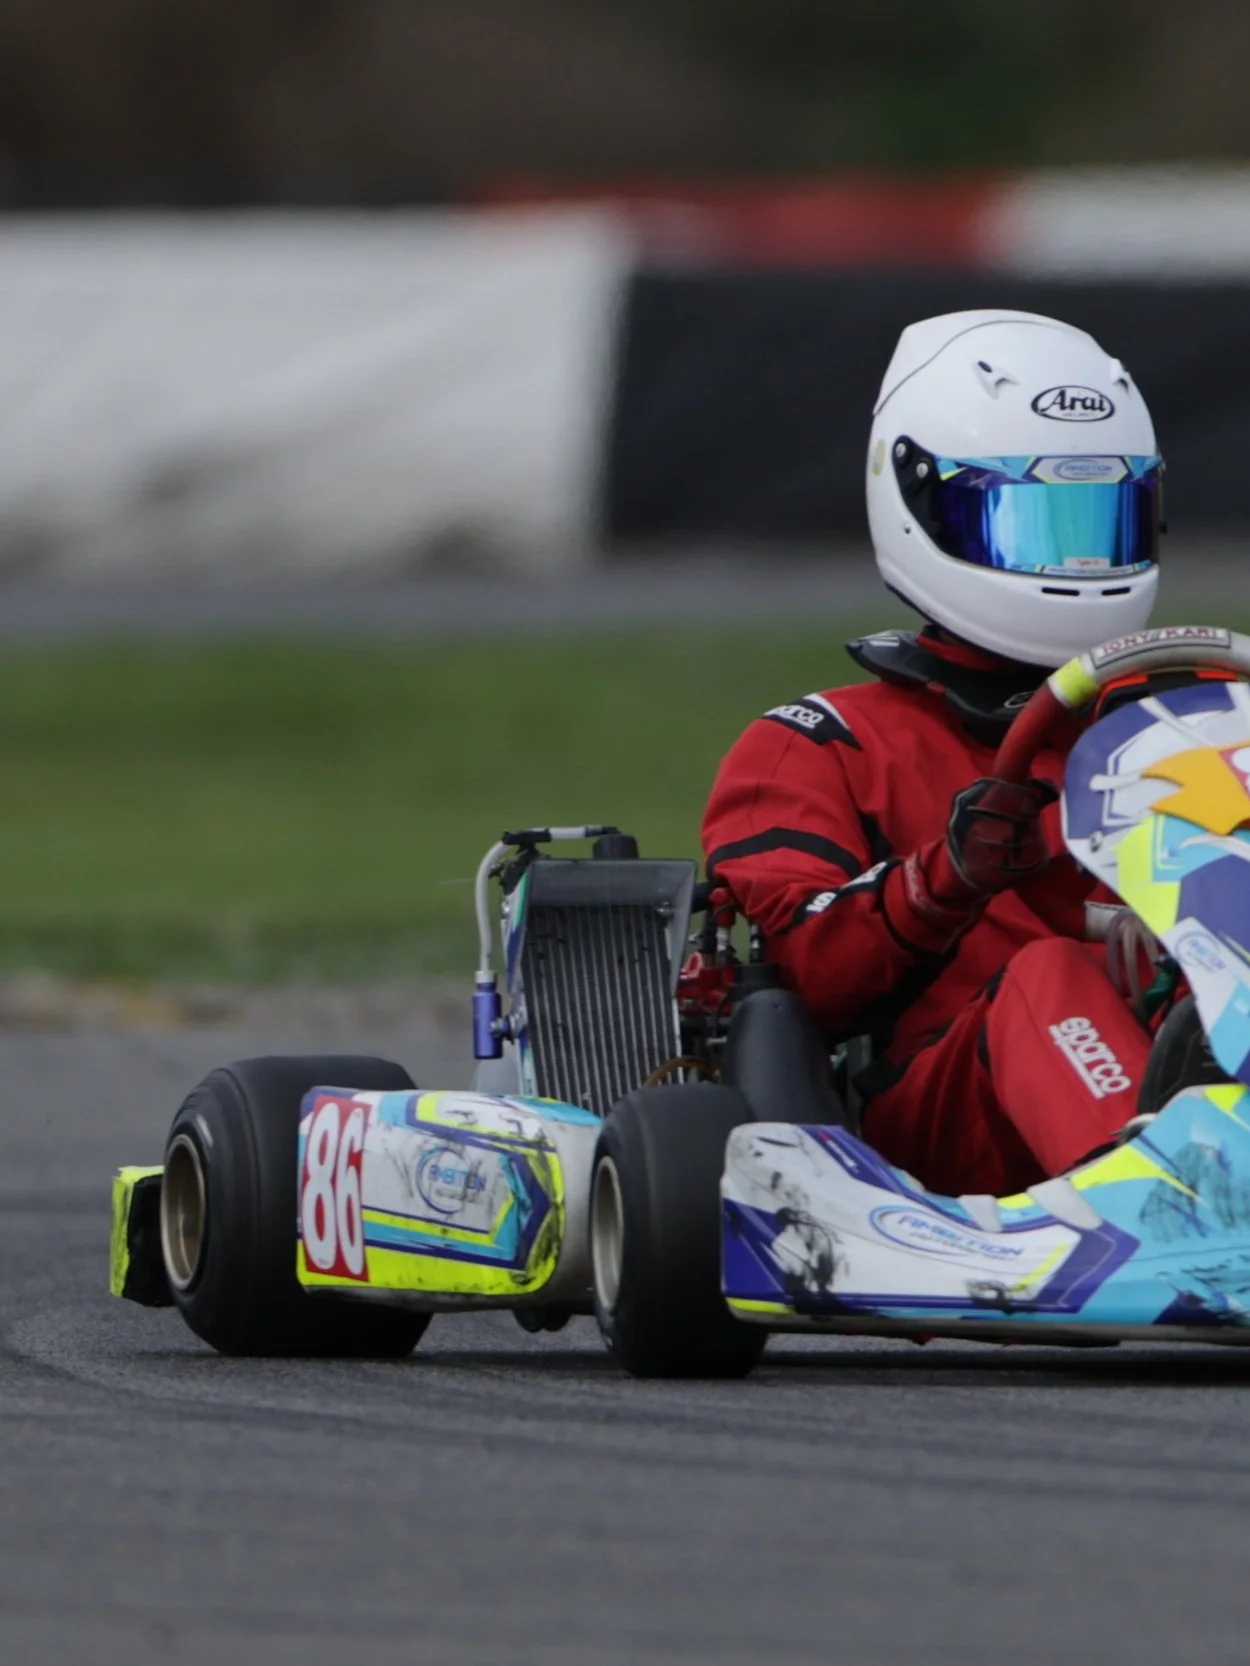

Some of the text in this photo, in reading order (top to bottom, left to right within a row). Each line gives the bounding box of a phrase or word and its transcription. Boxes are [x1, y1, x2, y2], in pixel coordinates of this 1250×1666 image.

[1039, 388, 1106, 412] Arai
[1048, 1016, 1132, 1099] sparco
[302, 1102, 366, 1276] 86
[898, 1214, 1024, 1256] AMBITION
